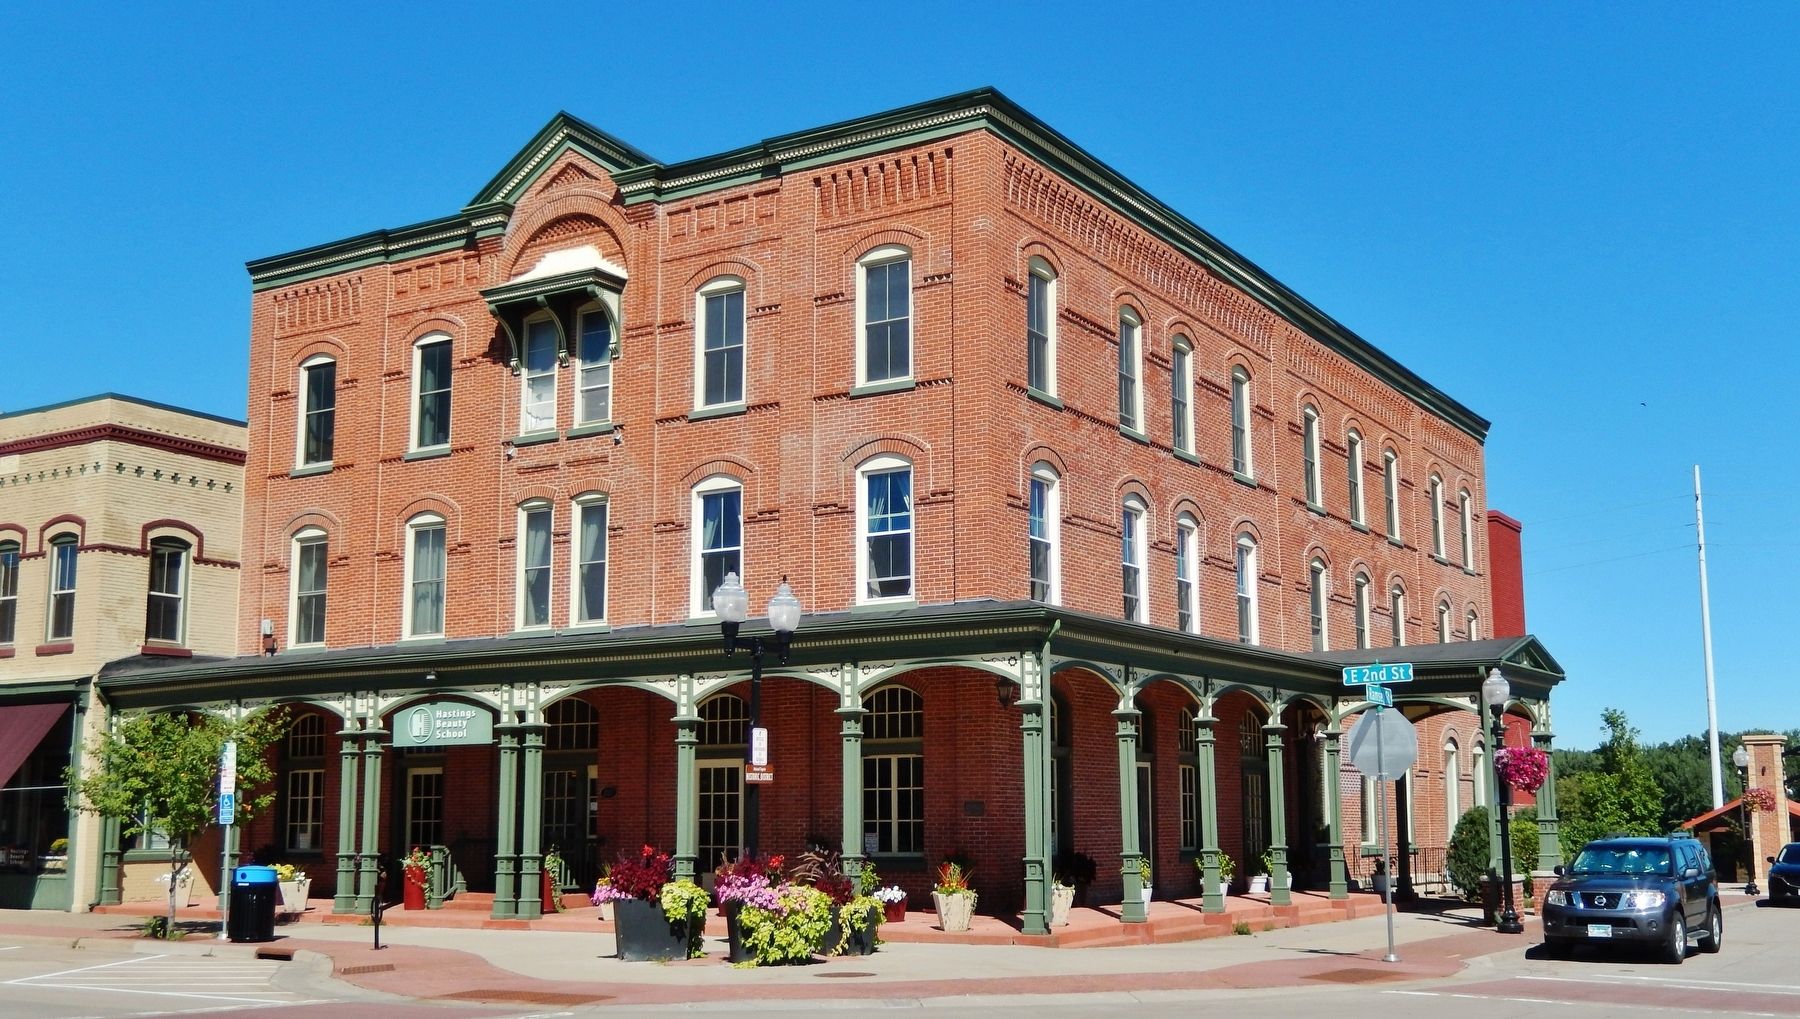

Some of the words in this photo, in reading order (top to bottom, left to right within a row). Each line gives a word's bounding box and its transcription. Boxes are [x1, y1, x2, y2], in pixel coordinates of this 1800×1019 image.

[1351, 670, 1358, 682] E
[1362, 668, 1386, 682] 2nd
[1391, 667, 1405, 680] St
[436, 709, 476, 719] Hastings
[436, 720, 467, 729] Beauty
[436, 729, 467, 739] School
